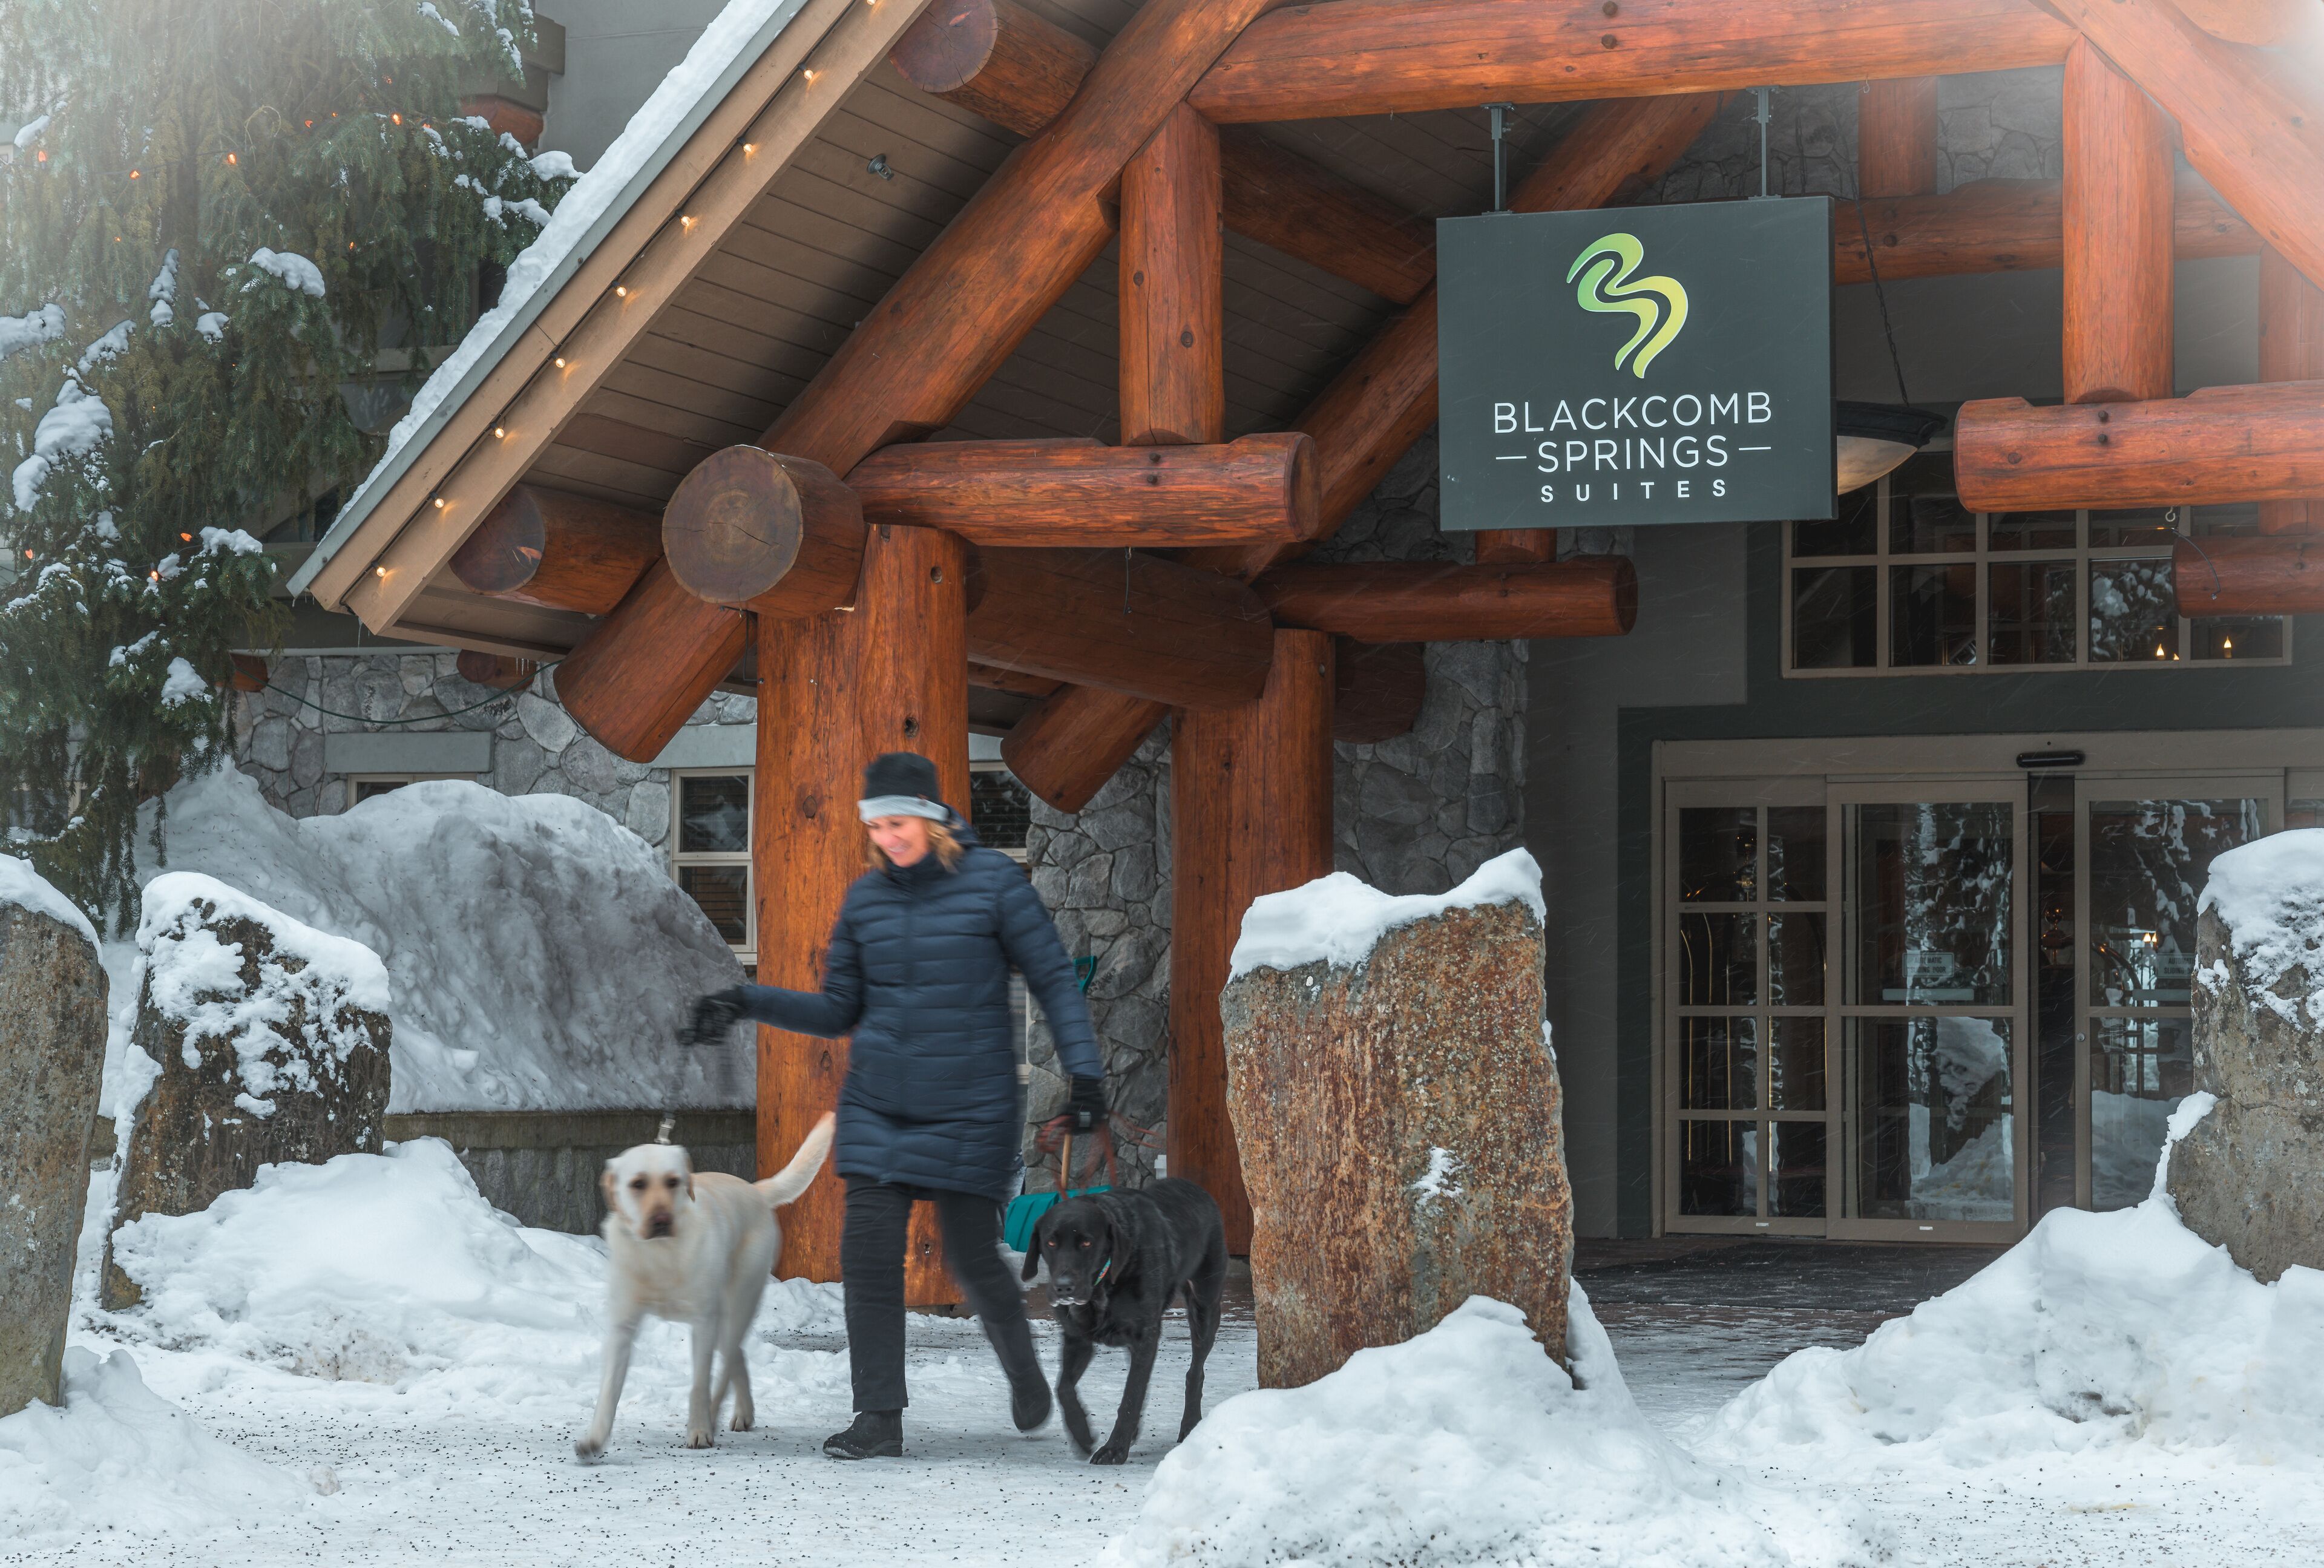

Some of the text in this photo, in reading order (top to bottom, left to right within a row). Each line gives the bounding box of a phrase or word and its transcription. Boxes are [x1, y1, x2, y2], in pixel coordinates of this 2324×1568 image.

[1494, 392, 1772, 434] BLACKCOMB
[1537, 435, 1728, 473] SPRINGS
[1540, 479, 1726, 503] SUITES
